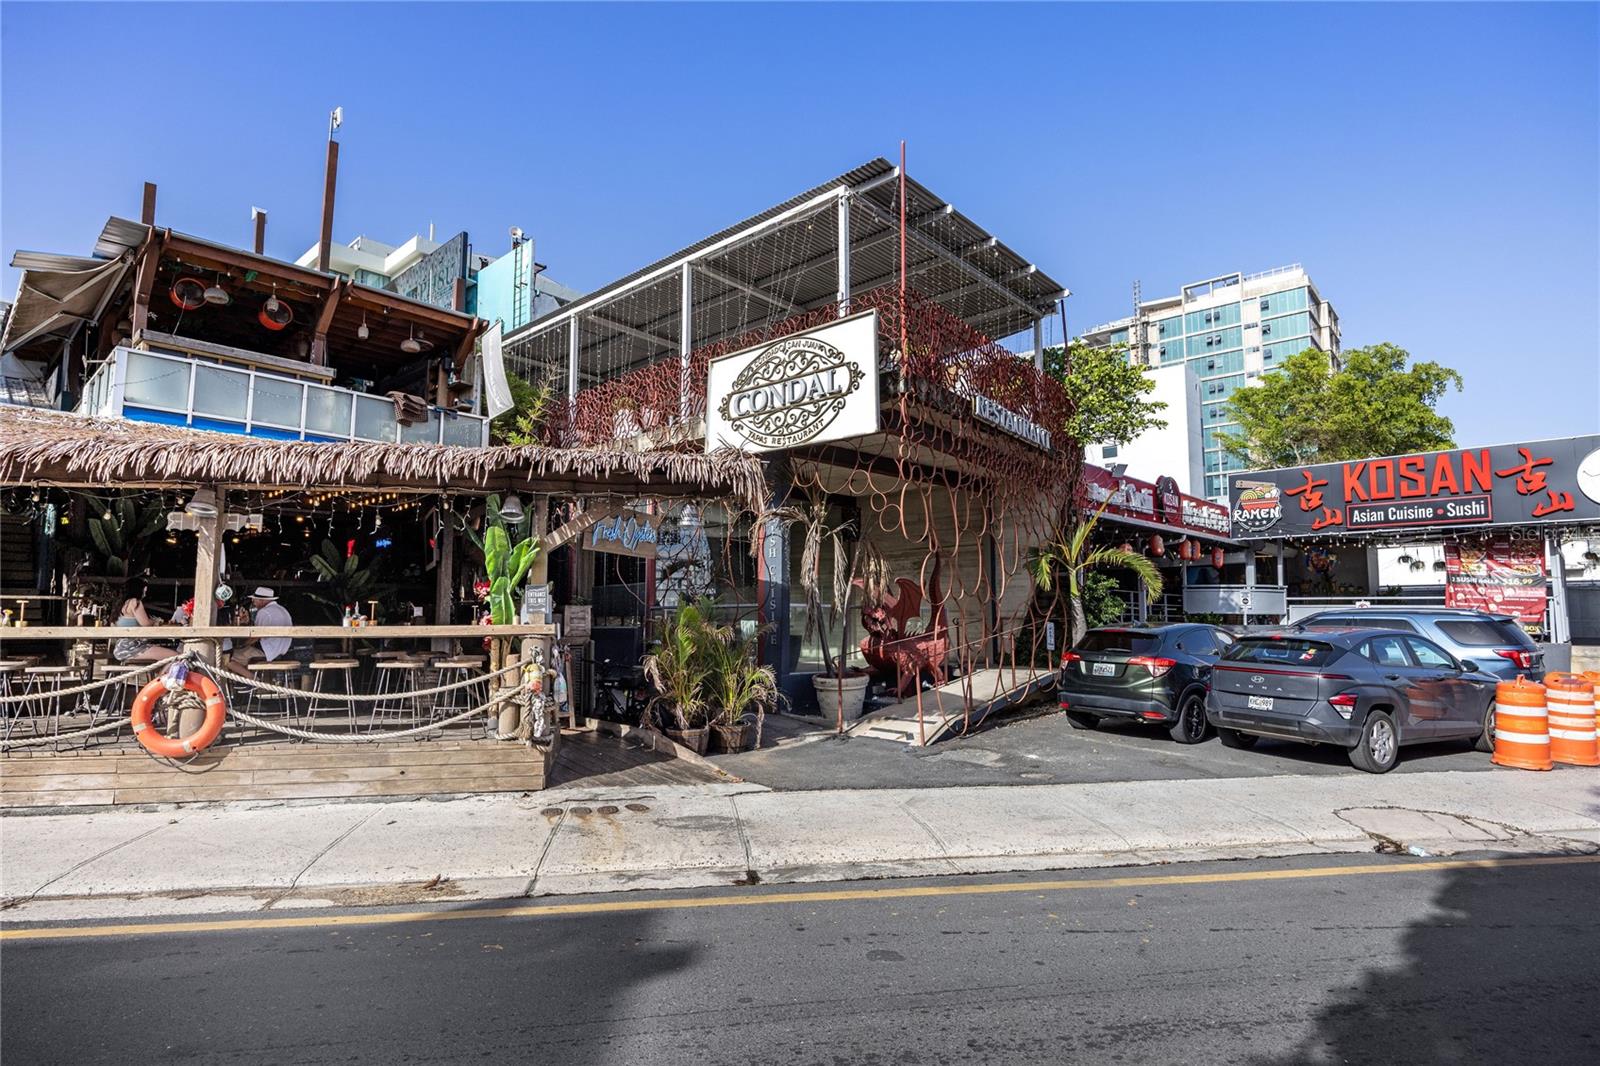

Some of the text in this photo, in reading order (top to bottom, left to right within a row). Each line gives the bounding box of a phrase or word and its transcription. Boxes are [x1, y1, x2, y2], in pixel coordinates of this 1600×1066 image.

[733, 368, 843, 418] CONDAL
[748, 418, 825, 445] TAPAS RESTAURANT
[975, 395, 1052, 450] RESTAURANT
[1343, 448, 1492, 502] KOSAN
[1233, 506, 1280, 522] RAMEN
[1352, 500, 1485, 523] Asian Cuisine Sushi
